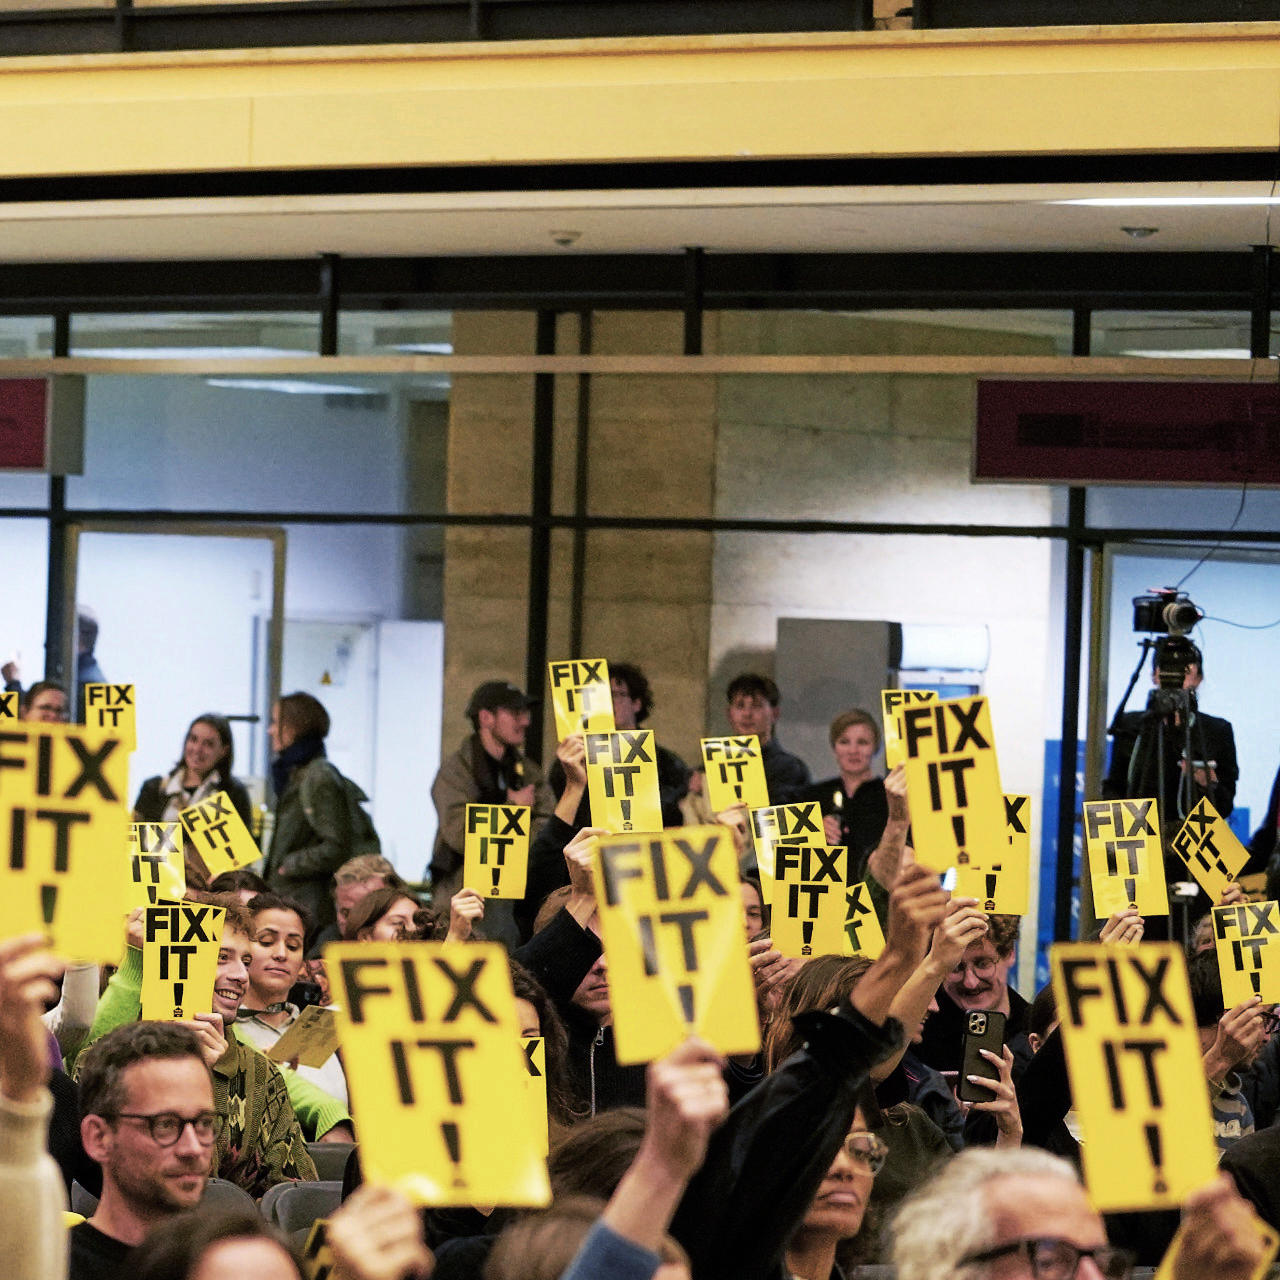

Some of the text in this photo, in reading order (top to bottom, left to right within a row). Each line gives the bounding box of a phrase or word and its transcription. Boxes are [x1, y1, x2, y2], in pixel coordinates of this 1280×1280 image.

[552, 660, 606, 688] FIX
[88, 684, 132, 706] FIX
[567, 687, 597, 712] IT
[98, 708, 124, 727] IT
[904, 701, 990, 757] FIX
[587, 732, 652, 766] FIX
[705, 738, 757, 761] FIX
[604, 766, 641, 797] IT
[719, 762, 748, 784] IT
[927, 758, 975, 811] IT
[184, 795, 231, 833] FIX
[468, 806, 526, 836] FIX
[620, 799, 633, 831] !
[751, 804, 821, 838] FIX
[1087, 801, 1154, 838] FIX
[1176, 801, 1218, 862] FIX
[10, 807, 89, 873] IT
[203, 825, 231, 850] IT
[479, 837, 513, 866] IT
[951, 815, 970, 864] !
[1197, 830, 1221, 871] IT
[132, 855, 167, 883] IT
[600, 837, 729, 907] FIX
[775, 847, 843, 882] FIX
[1106, 840, 1144, 875] IT
[491, 867, 500, 896] !
[788, 884, 828, 918] IT
[146, 907, 209, 943] FIX
[801, 921, 814, 955] !
[1216, 904, 1278, 939] FIX
[640, 912, 708, 976] IT
[1233, 939, 1266, 971] IT
[159, 945, 196, 980] IT
[173, 982, 184, 1018] !
[340, 957, 498, 1025] FIX
[1061, 955, 1183, 1027] FIX
[390, 1039, 475, 1105] IT
[1102, 1039, 1167, 1110] IT
